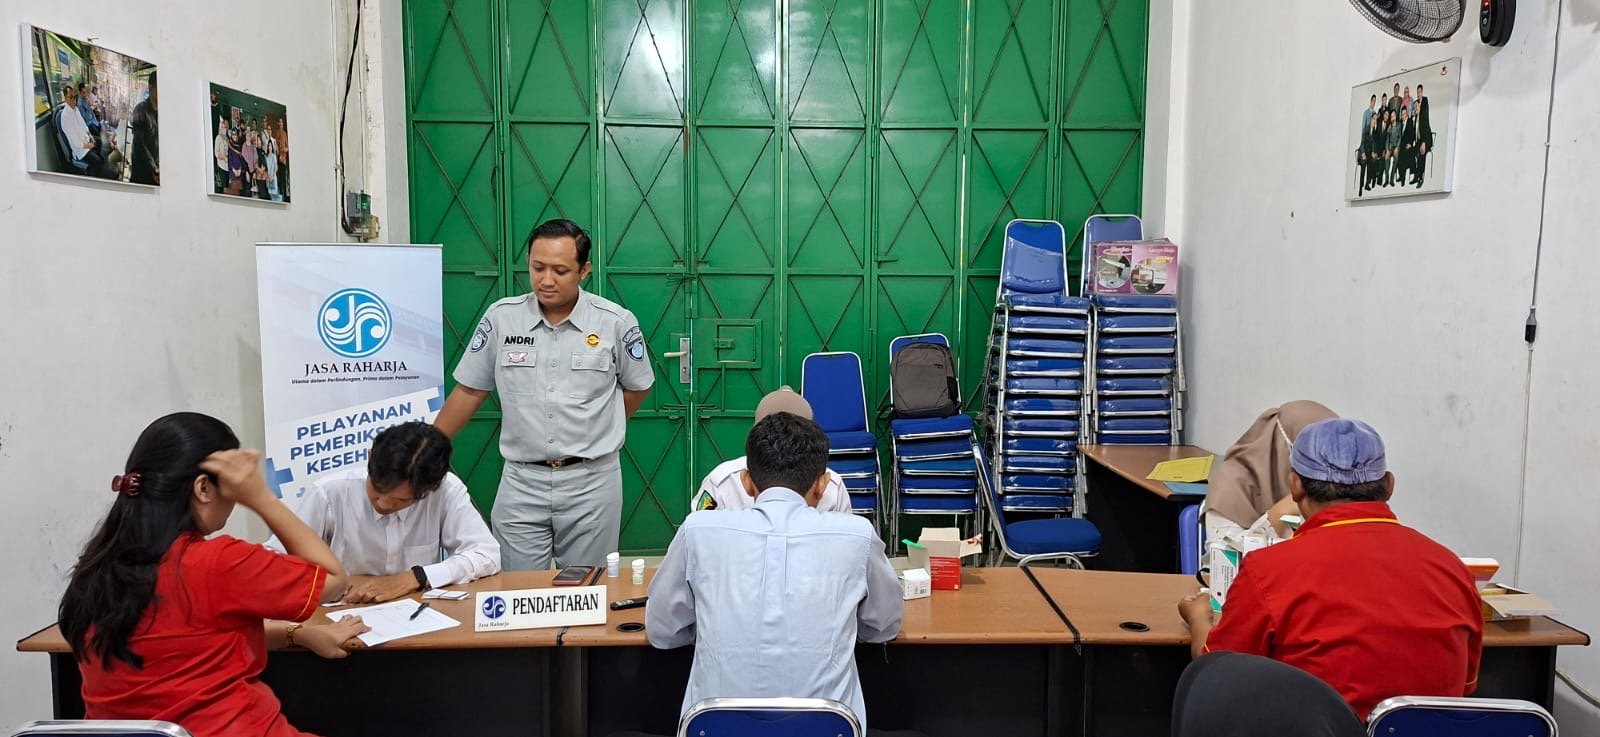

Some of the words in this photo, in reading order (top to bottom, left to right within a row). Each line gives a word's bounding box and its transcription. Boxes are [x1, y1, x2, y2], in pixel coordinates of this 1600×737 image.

[504, 336, 535, 345] ANDRI
[305, 363, 339, 377] JASA
[343, 361, 408, 374] RAHARJA
[297, 402, 411, 440] PELAYANAN
[290, 417, 426, 460] PEMERIKS
[306, 448, 368, 475] KESEH
[512, 593, 599, 615] PENDAFTARAN
